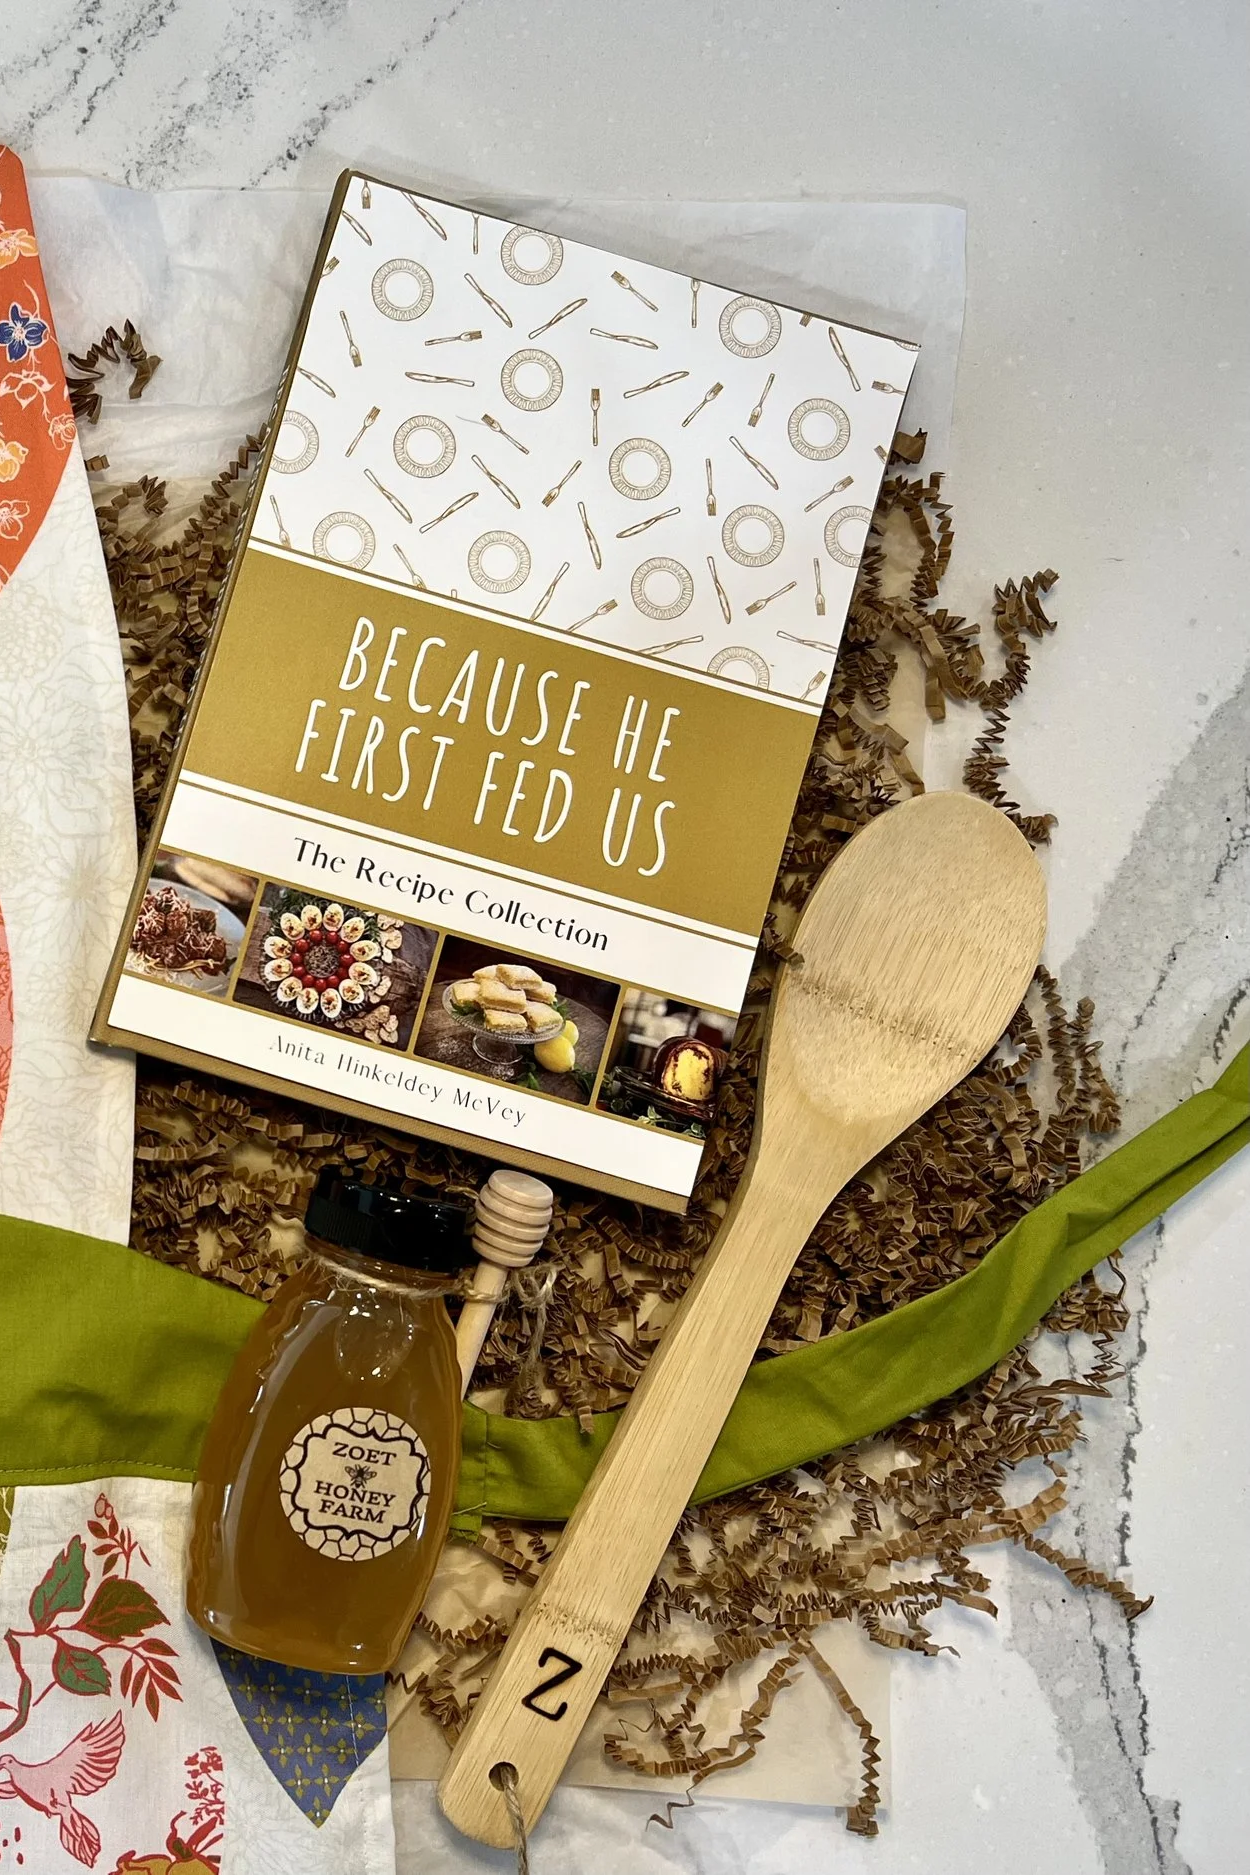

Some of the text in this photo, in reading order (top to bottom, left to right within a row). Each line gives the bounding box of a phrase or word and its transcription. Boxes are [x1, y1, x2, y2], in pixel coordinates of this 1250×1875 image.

[339, 617, 681, 782] BECAUSE HE
[295, 699, 676, 877] FIRST FED US
[293, 836, 610, 952] The Recipe Collection
[269, 1035, 528, 1129] Anita Hinkeldey McVey
[313, 1480, 396, 1508] HONEY
[332, 1442, 397, 1466] ZOET
[318, 1499, 386, 1524] FARM
[521, 1647, 583, 1722] Z
